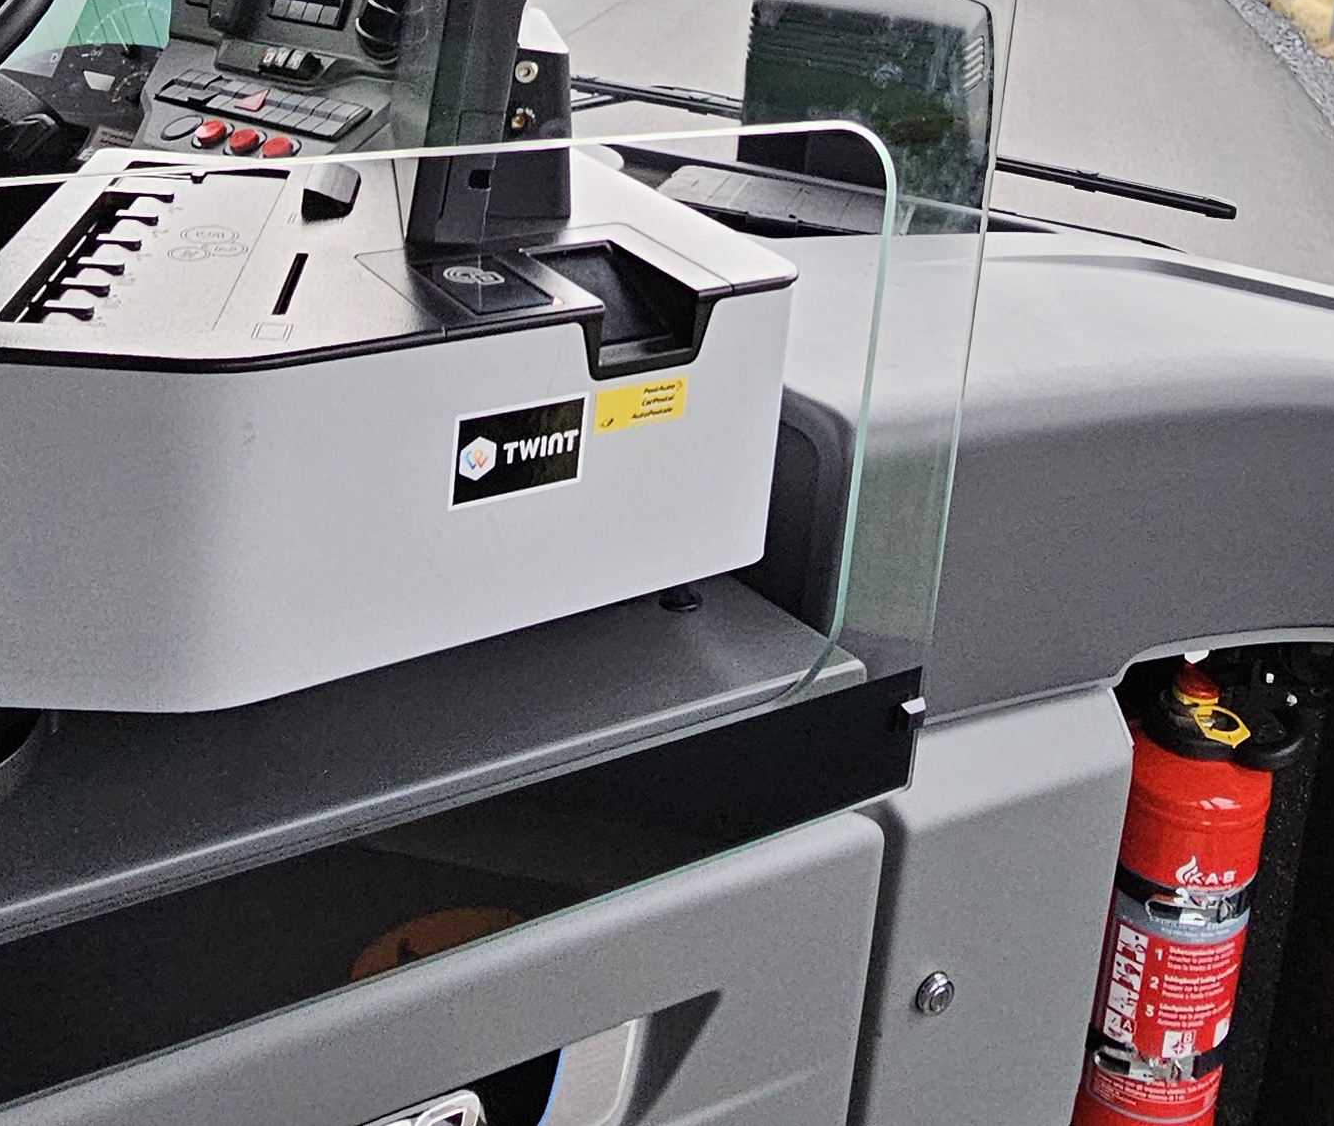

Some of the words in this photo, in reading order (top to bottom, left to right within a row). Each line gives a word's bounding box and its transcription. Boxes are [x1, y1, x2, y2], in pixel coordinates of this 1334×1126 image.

[503, 428, 579, 465] TWINT
[1155, 948, 1163, 961] 1
[1149, 976, 1160, 989] 2
[1122, 1019, 1133, 1031] A
